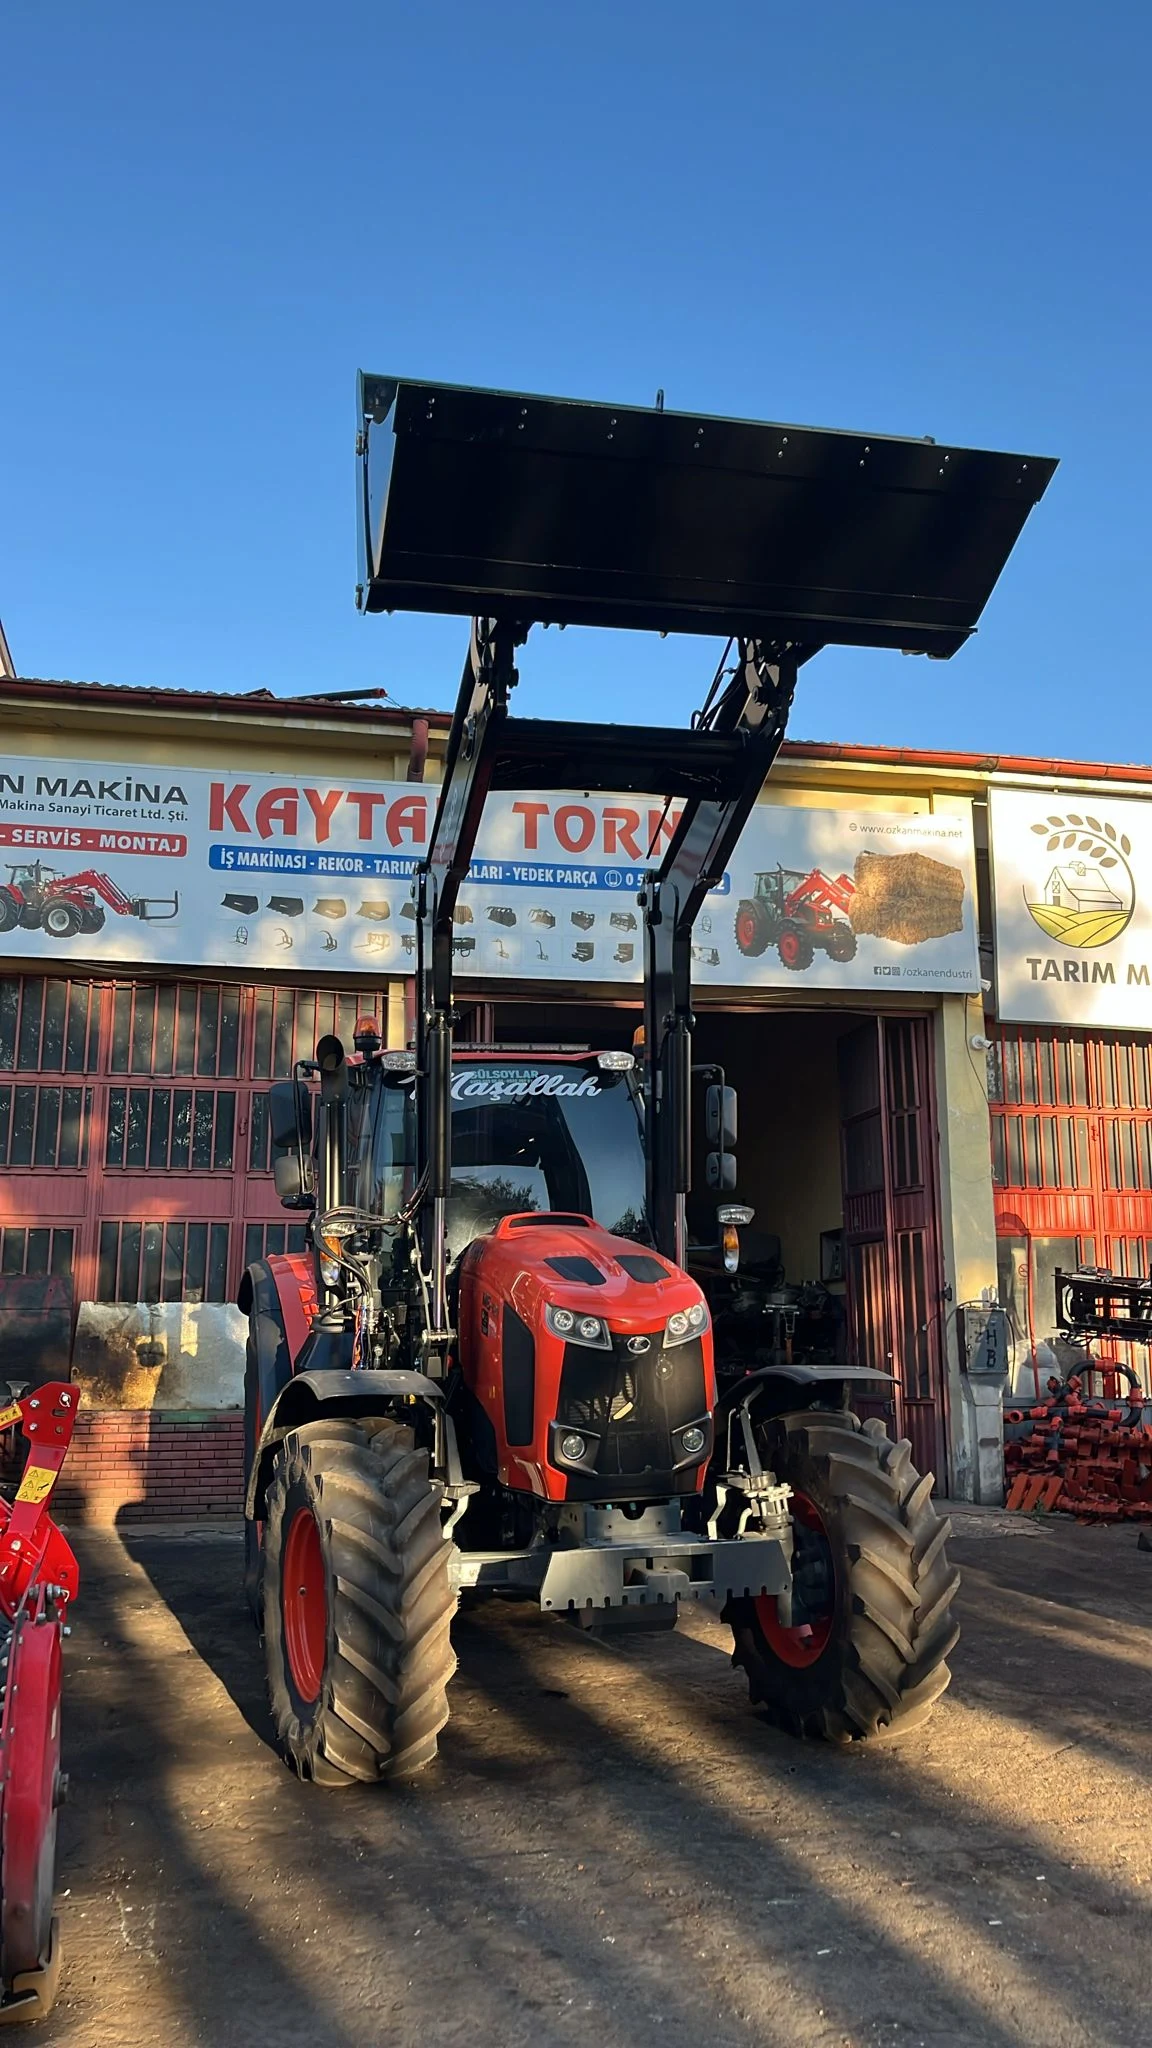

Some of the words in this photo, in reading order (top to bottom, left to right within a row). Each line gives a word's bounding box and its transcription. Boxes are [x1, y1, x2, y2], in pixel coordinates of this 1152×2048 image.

[36, 776, 189, 806] MAKİNA
[0, 799, 45, 812] Makina
[48, 802, 91, 817] Sanayi
[94, 805, 137, 819] Ticaret
[141, 808, 165, 820] Ltd.
[168, 810, 188, 823] Şti.
[209, 782, 442, 848] KAYTA
[512, 802, 684, 861] TORN
[11, 828, 81, 846] SERVİS
[100, 834, 181, 853] MONTAJ
[859, 824, 963, 838] www.ozkanmakina.net
[220, 847, 234, 868] İŞ
[237, 850, 307, 869] MAKİNASI
[318, 857, 363, 873] REKOR
[512, 867, 556, 882] YEDEK
[557, 870, 598, 888] PARÇA
[902, 967, 973, 979] /ozkanendustri
[1026, 957, 1116, 984] TARIM
[1127, 963, 1150, 986] M
